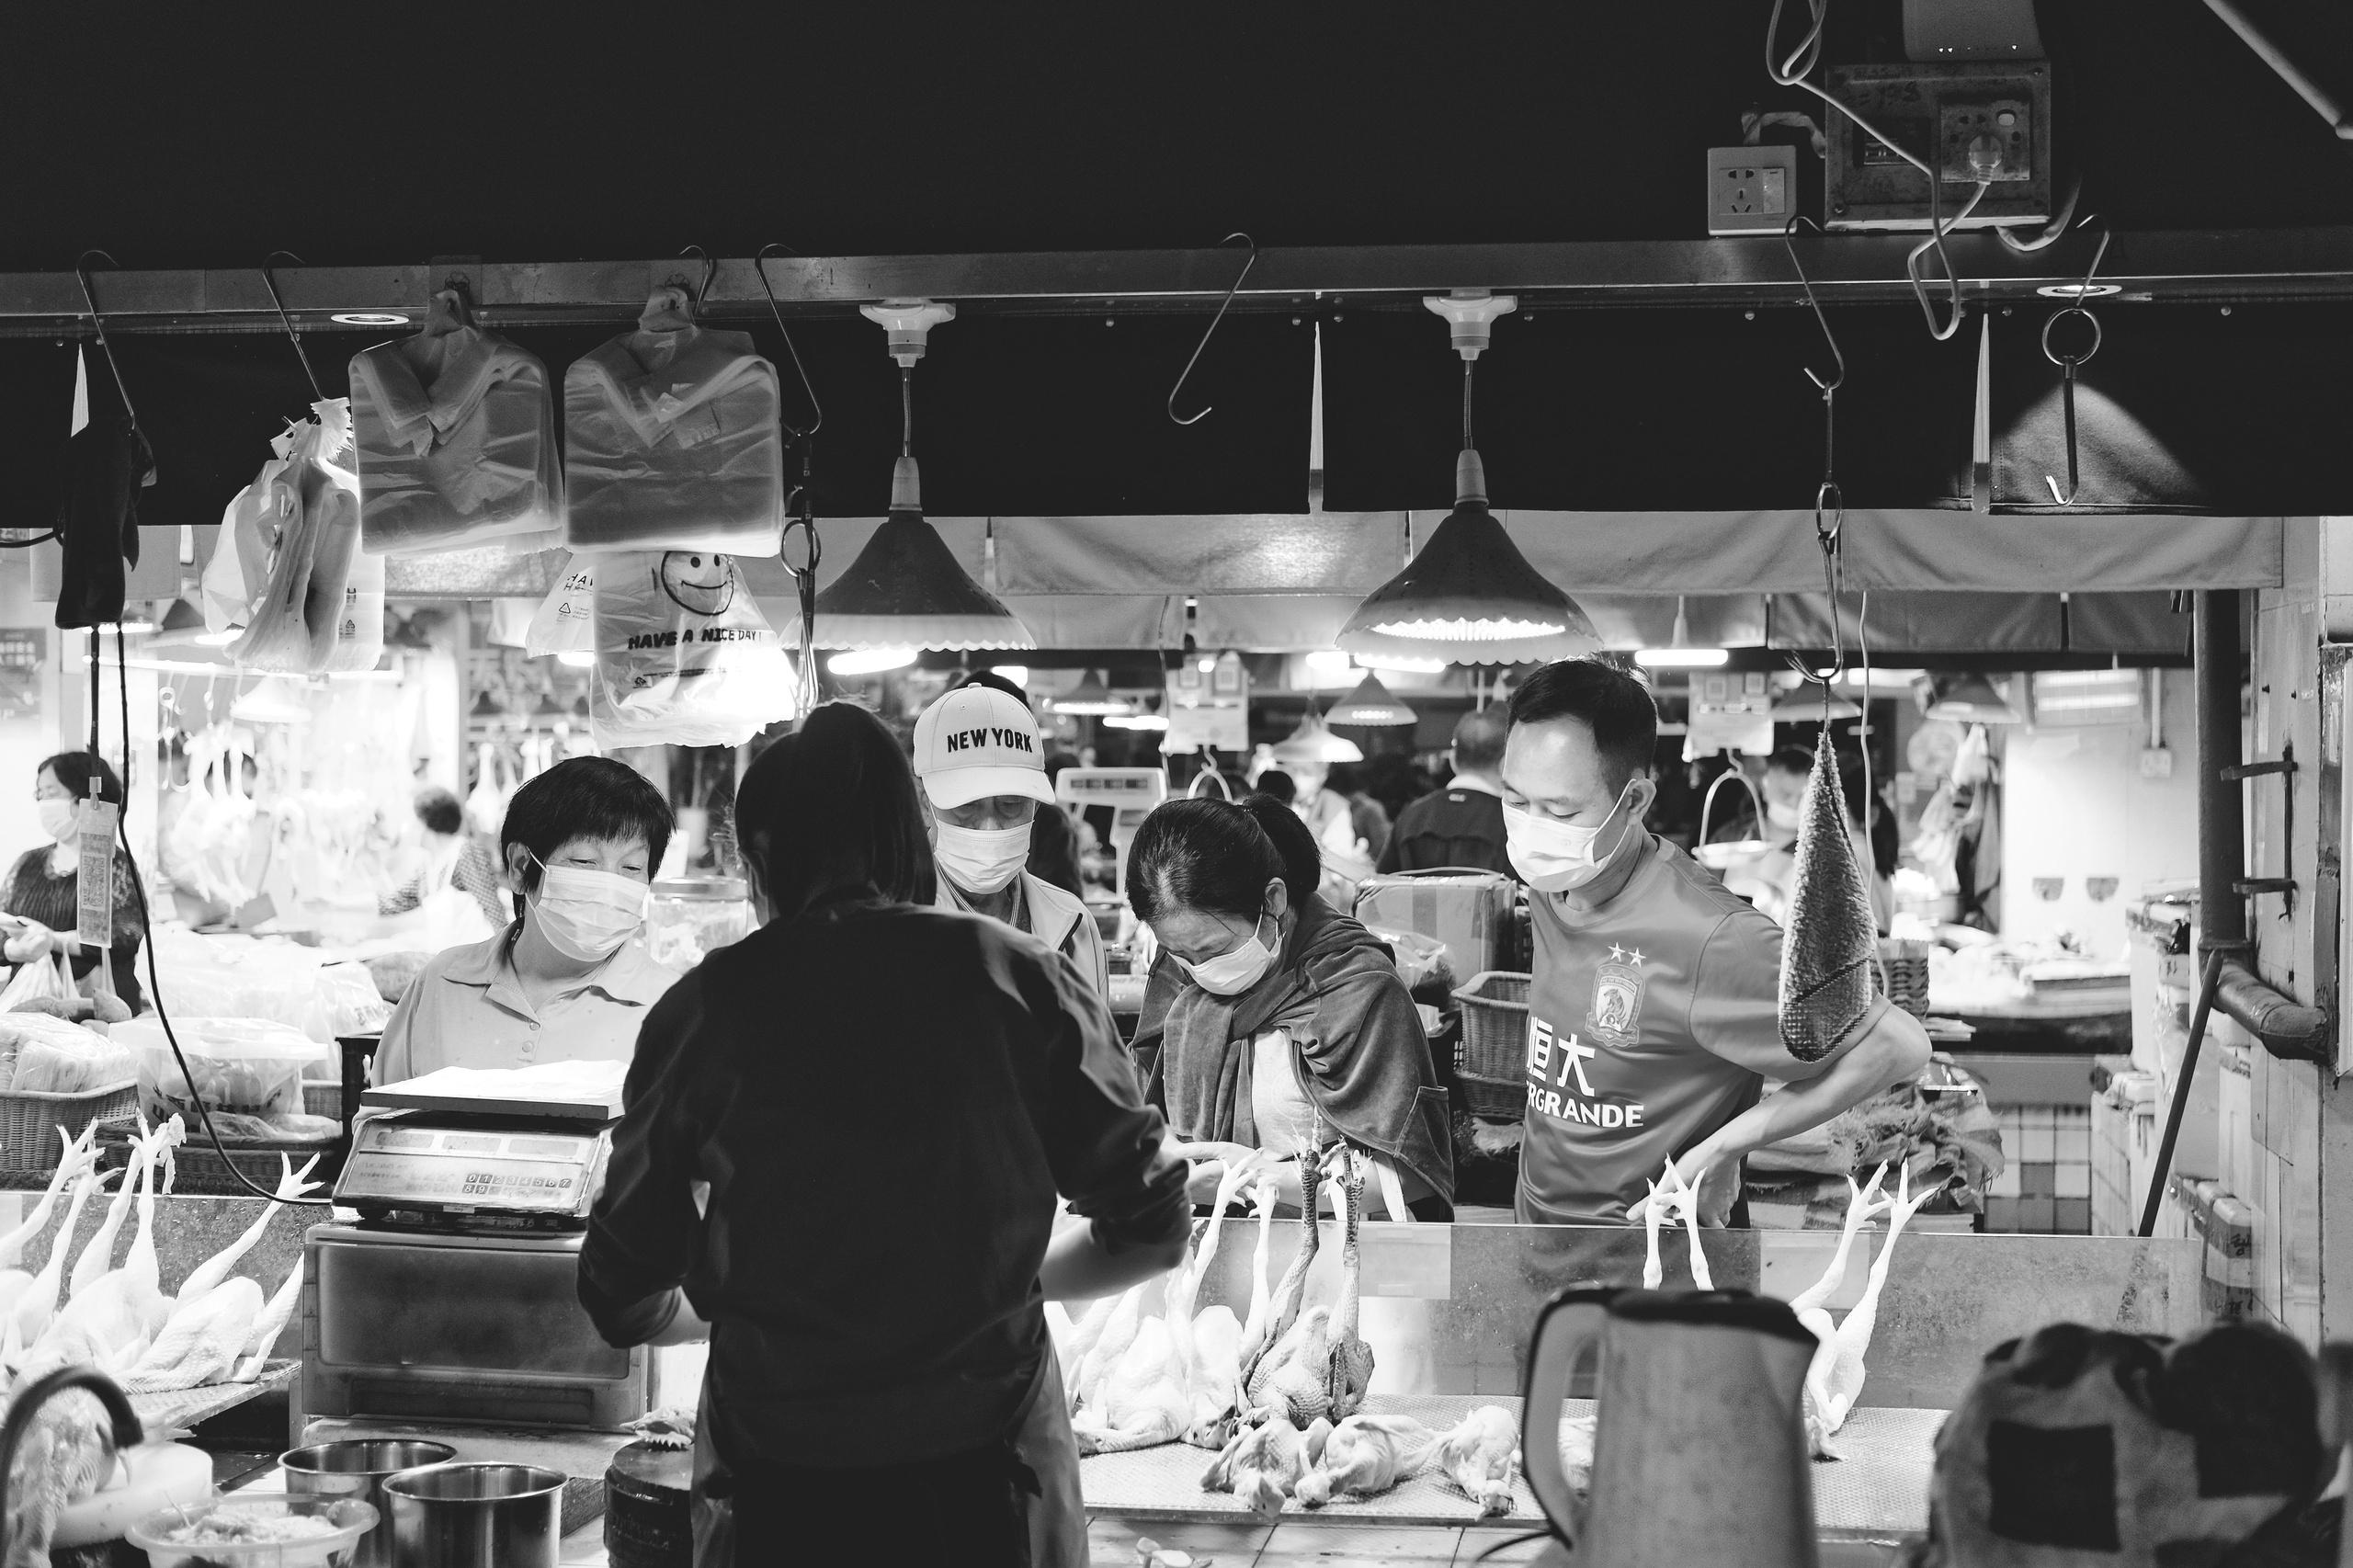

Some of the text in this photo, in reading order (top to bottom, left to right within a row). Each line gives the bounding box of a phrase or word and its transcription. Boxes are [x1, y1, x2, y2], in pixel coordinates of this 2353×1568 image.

[628, 631, 677, 650] HAVE
[682, 630, 694, 642] A
[701, 628, 735, 642] NICE
[947, 727, 1032, 753] NEW YORK
[1526, 1079, 1644, 1129] RGRANDE
